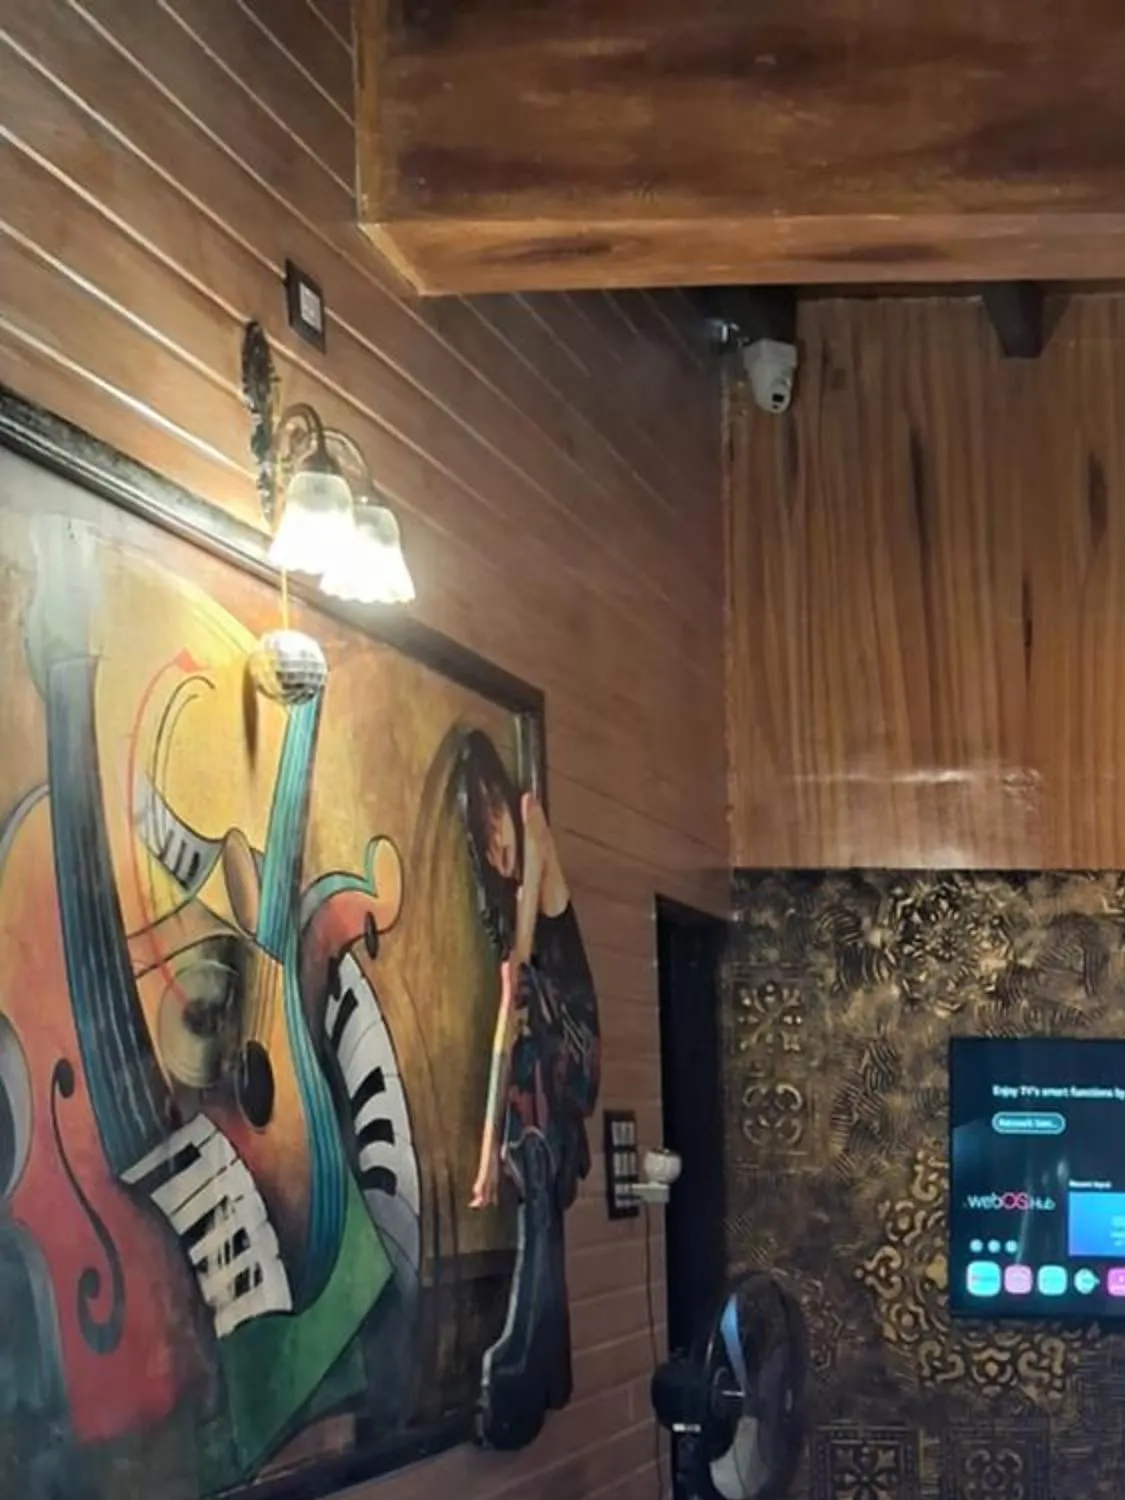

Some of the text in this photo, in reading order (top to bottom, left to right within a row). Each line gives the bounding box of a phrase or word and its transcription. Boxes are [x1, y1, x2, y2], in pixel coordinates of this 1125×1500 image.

[992, 1084, 1018, 1099] Enjoy
[1020, 1085, 1040, 1097] TV's
[1042, 1086, 1069, 1098] smart
[1070, 1085, 1113, 1099] functions
[1114, 1086, 1125, 1101] by
